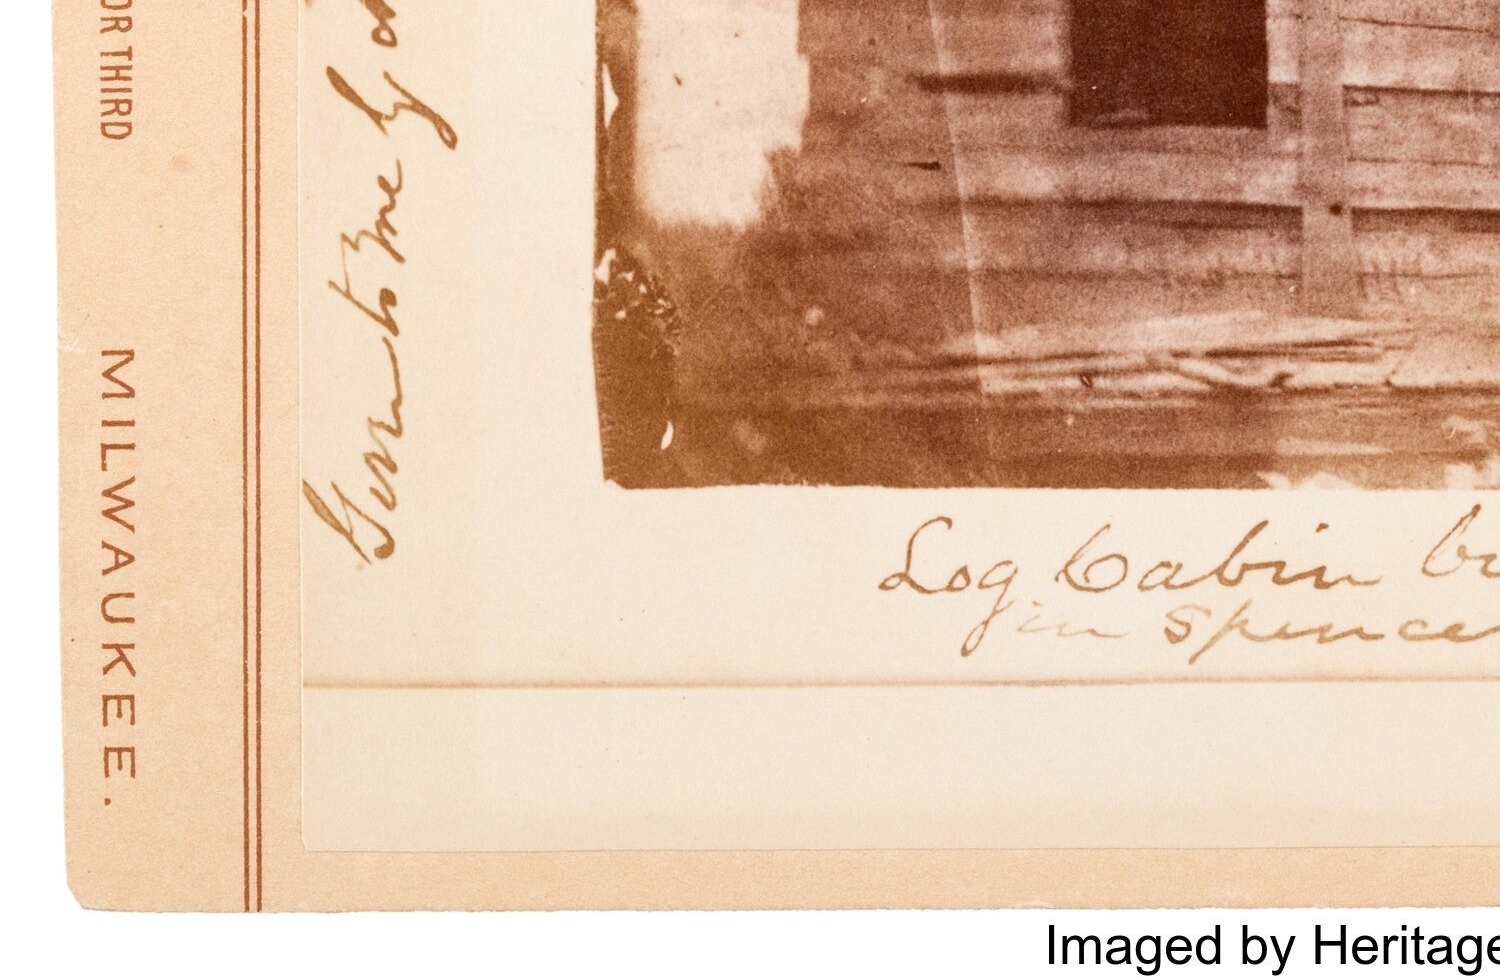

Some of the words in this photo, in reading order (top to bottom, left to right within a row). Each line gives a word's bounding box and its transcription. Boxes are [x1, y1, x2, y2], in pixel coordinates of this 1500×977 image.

[98, 45, 135, 141] THIRD
[324, 64, 460, 152] by
[100, 348, 137, 807] MILWAUKEE.
[876, 515, 1019, 659] Log
[1053, 519, 1384, 595] Cabin
[1015, 600, 1130, 639] in
